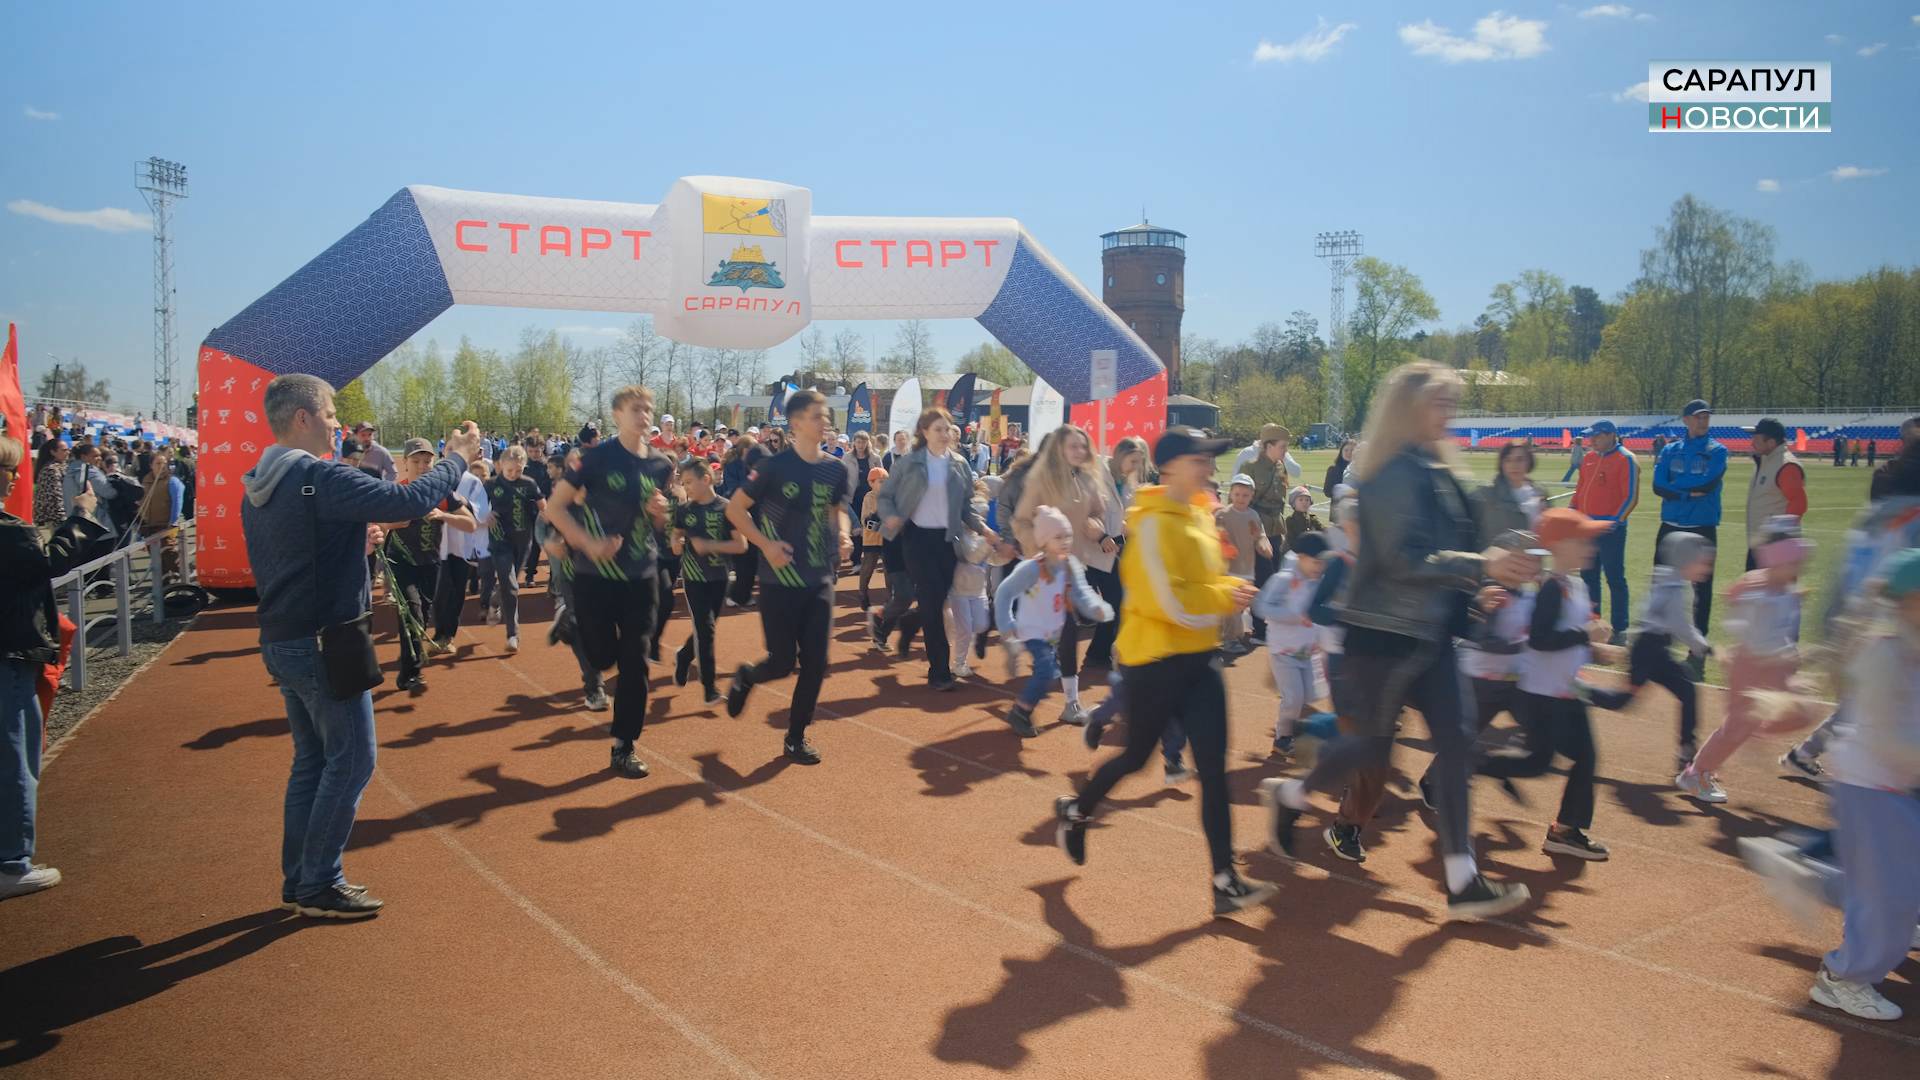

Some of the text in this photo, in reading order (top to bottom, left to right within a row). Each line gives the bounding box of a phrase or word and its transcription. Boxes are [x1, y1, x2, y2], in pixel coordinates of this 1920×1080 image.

[455, 220, 652, 261] СТАРТ
[835, 240, 999, 268] СТАРТ
[684, 296, 801, 316] САРАПУЛ
[704, 510, 721, 568] KATE
